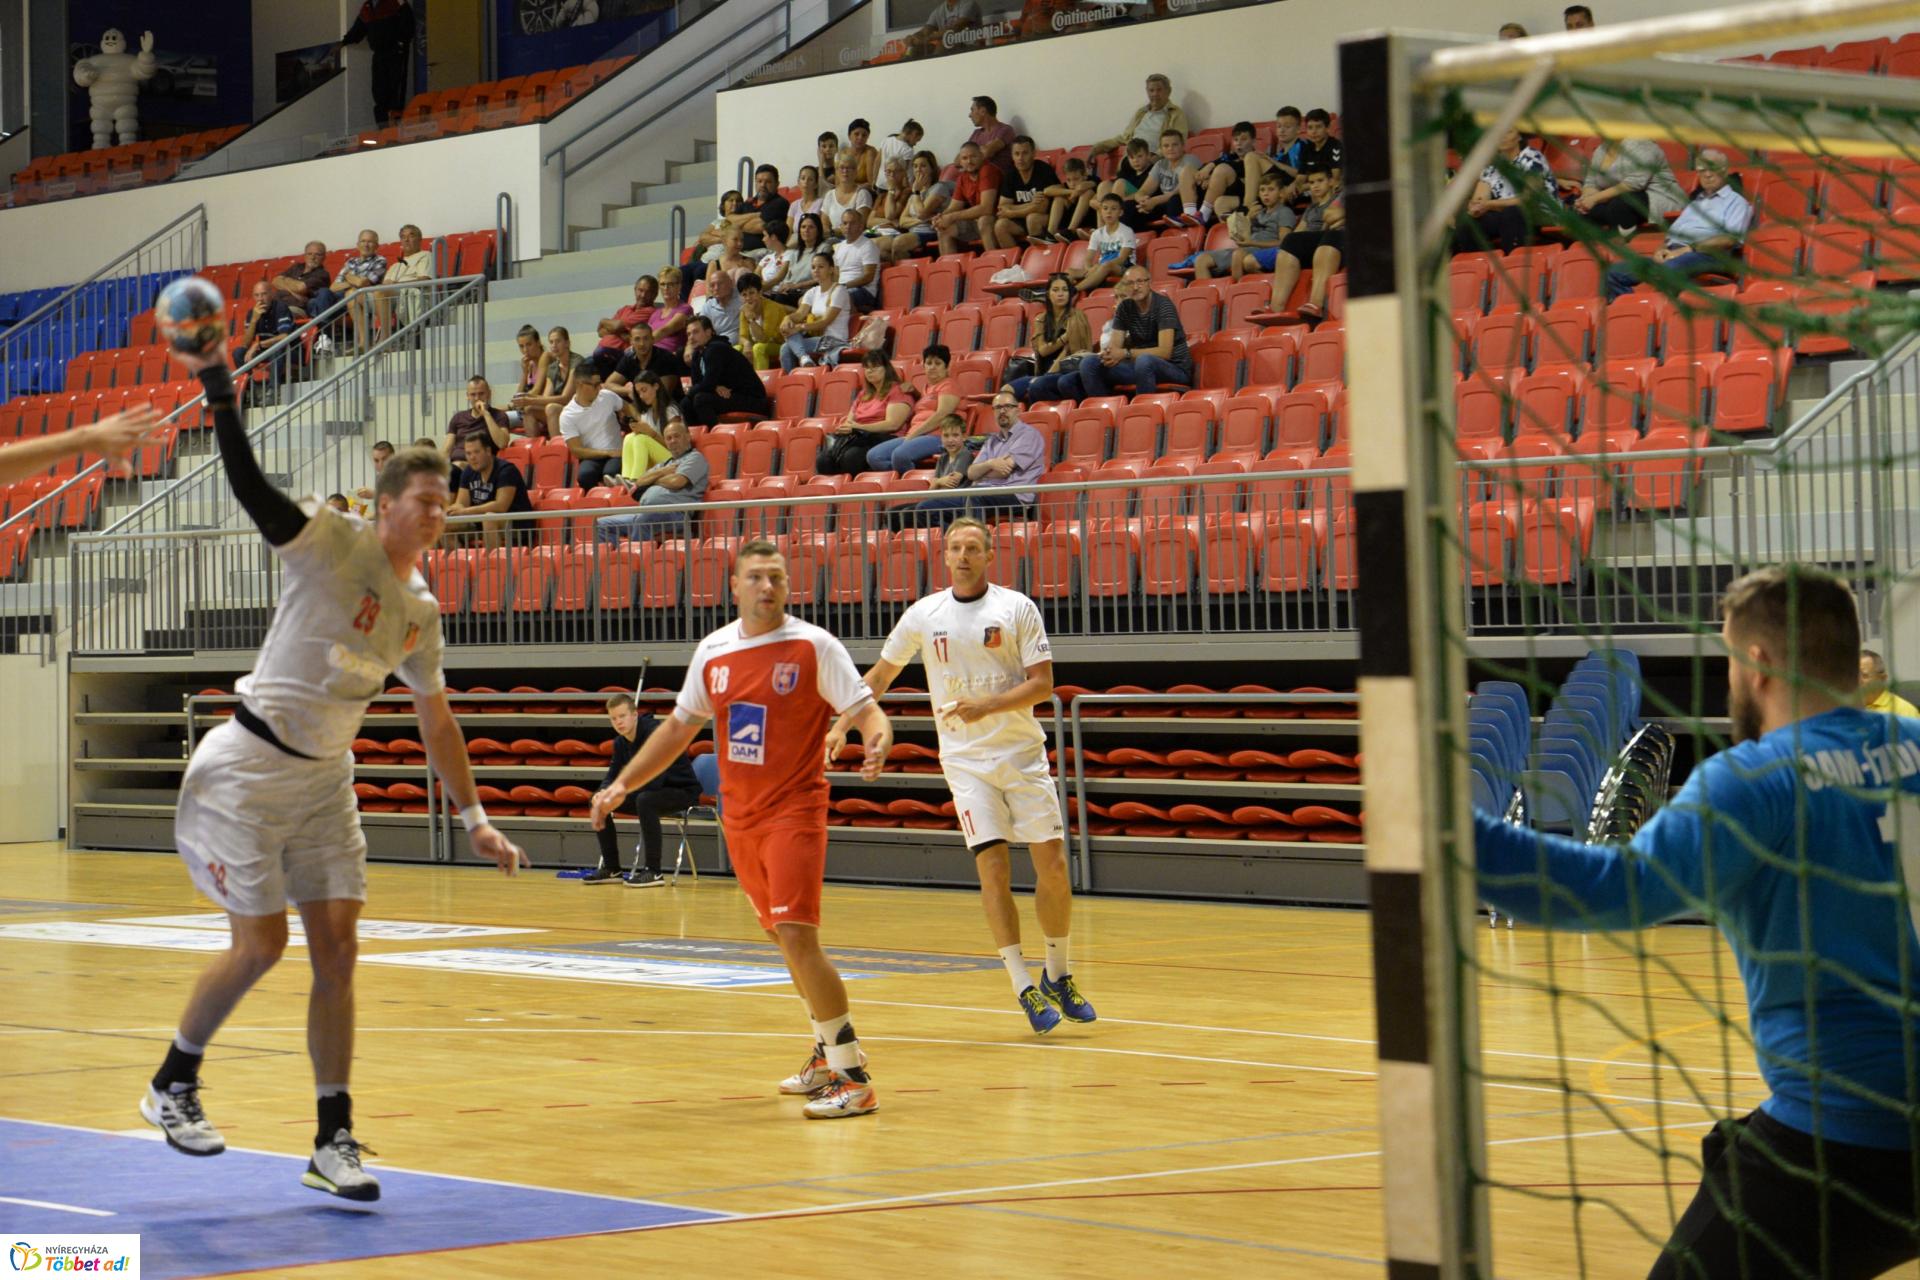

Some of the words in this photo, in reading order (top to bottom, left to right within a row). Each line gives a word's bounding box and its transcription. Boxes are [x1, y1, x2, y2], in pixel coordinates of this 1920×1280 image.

[1051, 3, 1117, 31] Continental
[942, 20, 1004, 49] Continental
[933, 638, 948, 662] 17
[710, 666, 729, 694] 28
[962, 810, 975, 837] 17
